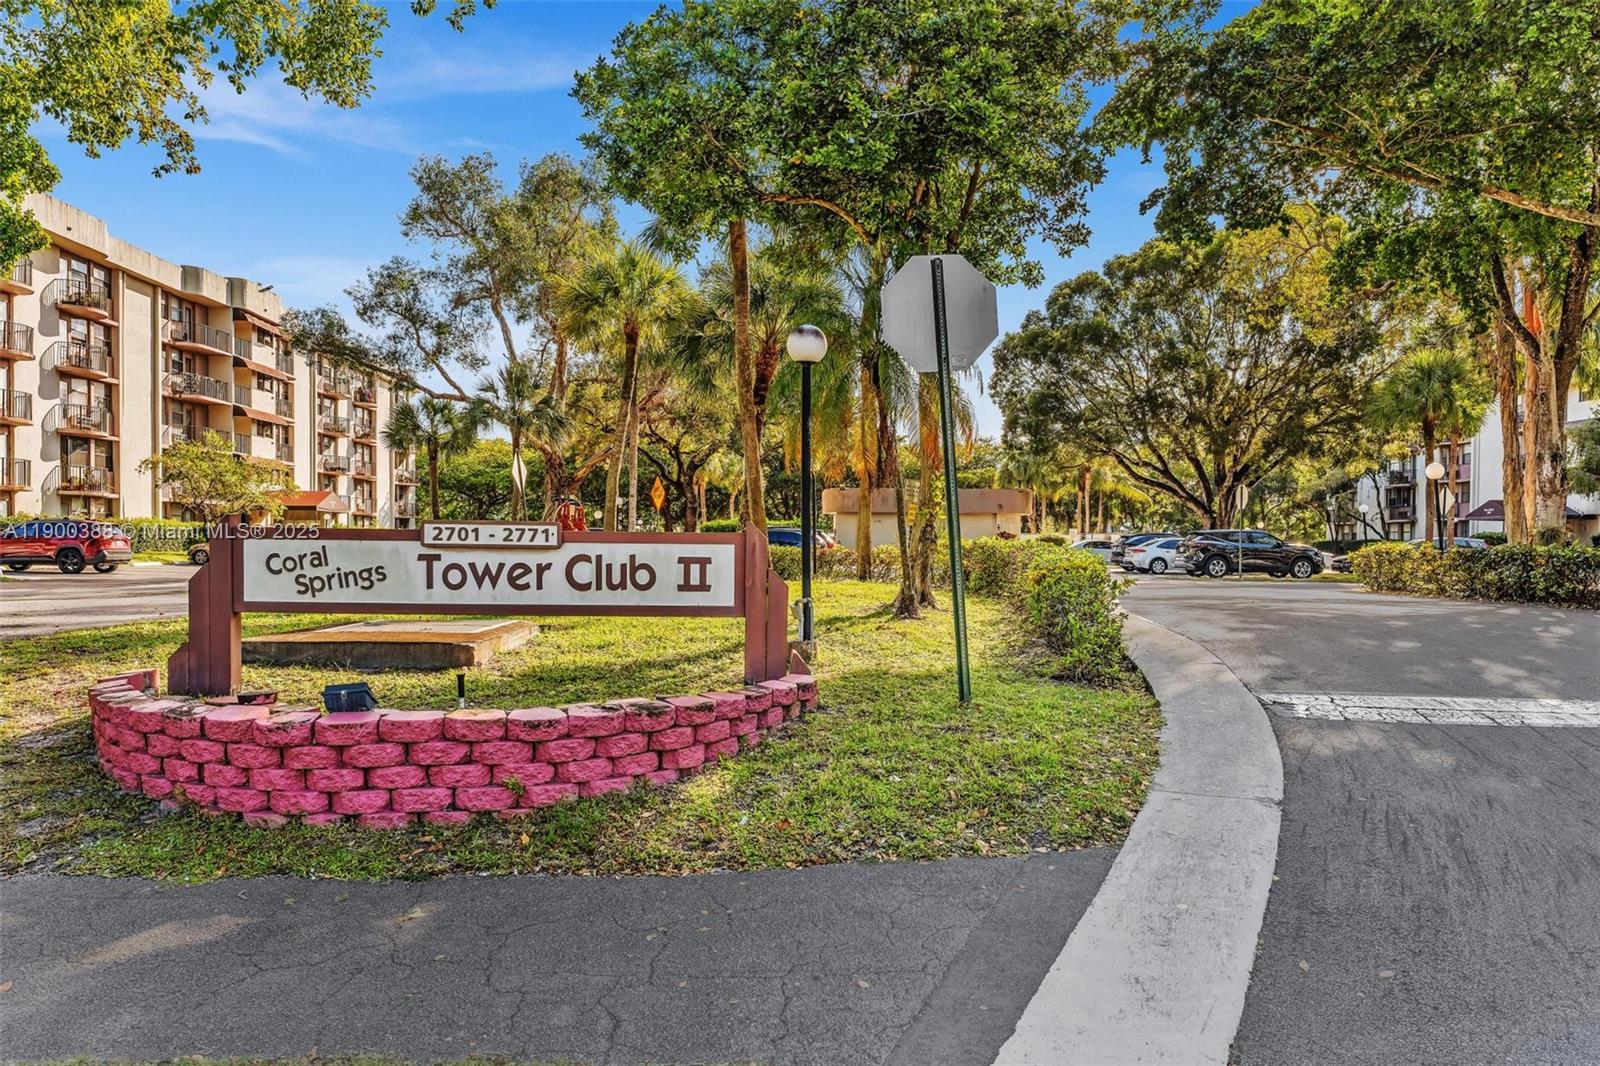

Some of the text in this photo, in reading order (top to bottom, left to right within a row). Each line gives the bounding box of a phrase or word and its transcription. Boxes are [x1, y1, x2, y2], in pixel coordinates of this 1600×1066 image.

[432, 526, 480, 542] 2701
[502, 527, 550, 543] 2771
[265, 545, 329, 576] Coral
[417, 553, 713, 593] Tower Club II
[294, 565, 388, 599] Springs
